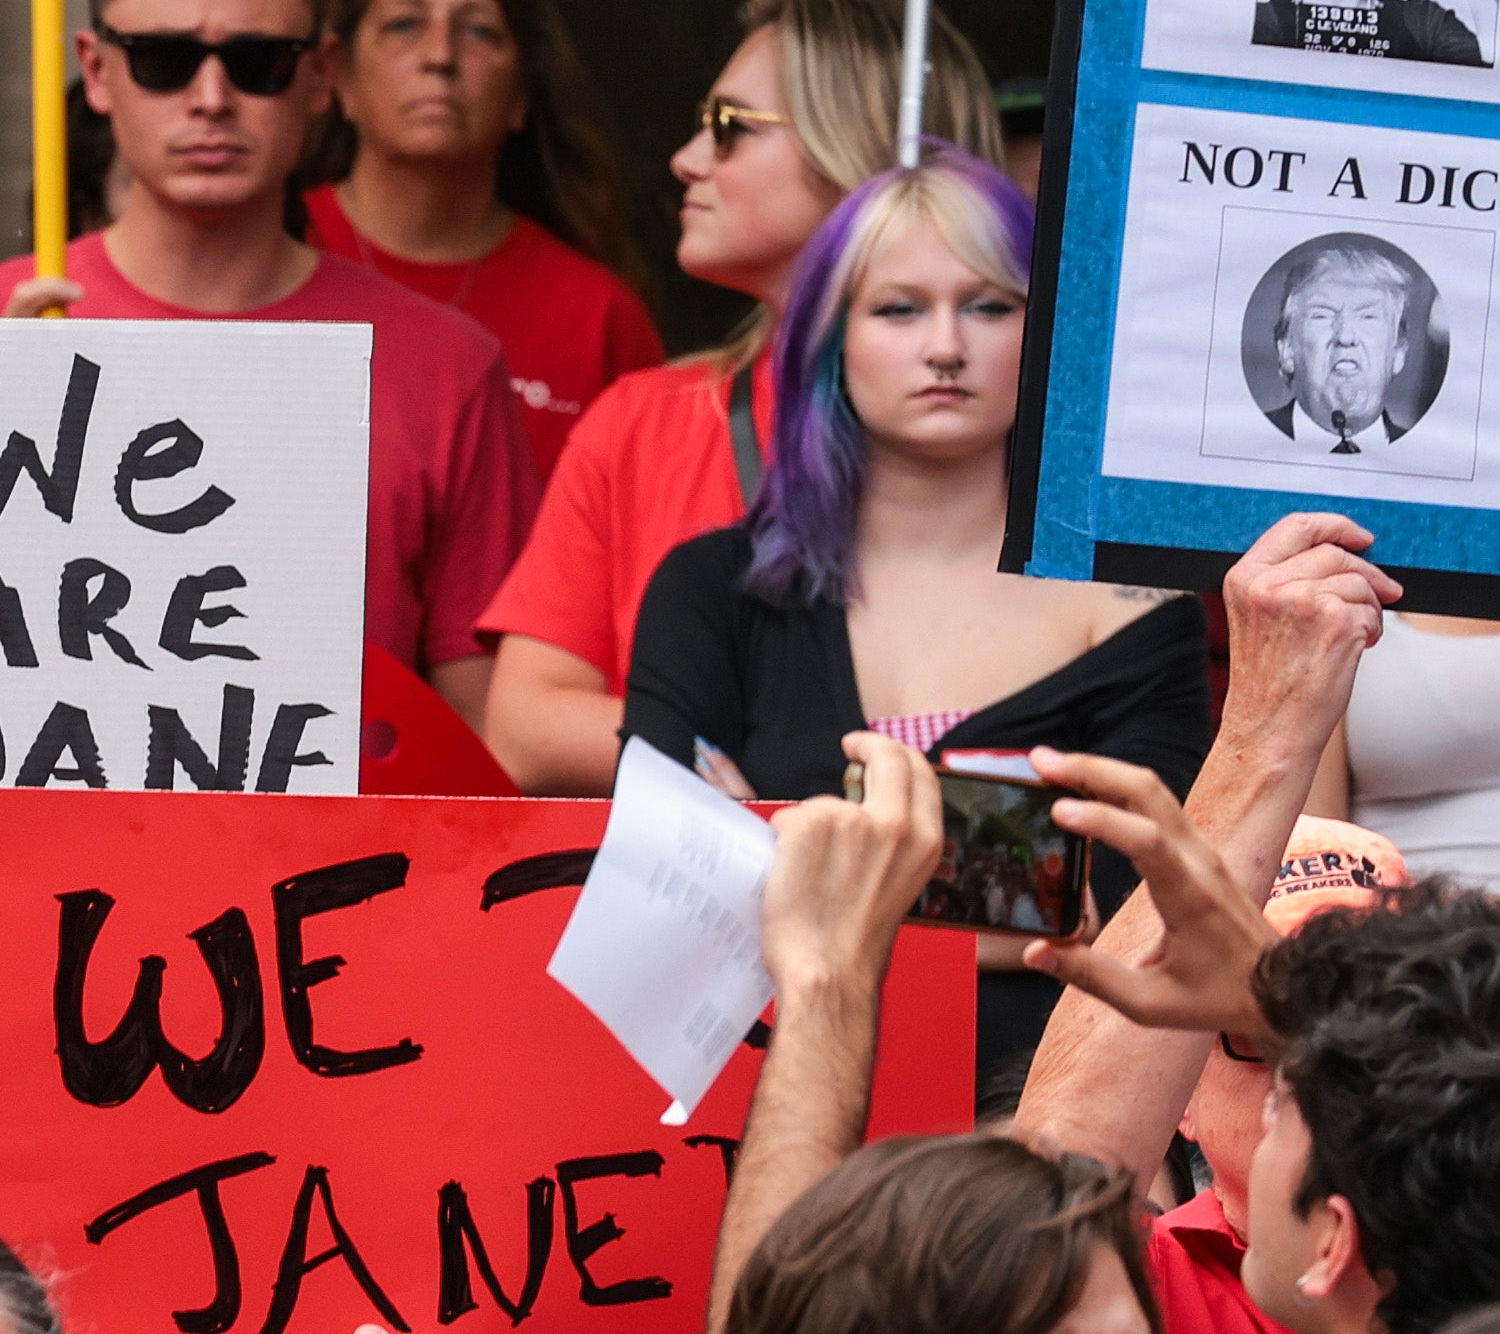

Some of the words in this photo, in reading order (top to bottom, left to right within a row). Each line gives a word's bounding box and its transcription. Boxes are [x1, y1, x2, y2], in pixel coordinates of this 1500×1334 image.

[1178, 140, 1306, 193] NOT
[1327, 156, 1369, 200] A
[53, 851, 424, 1115] WE
